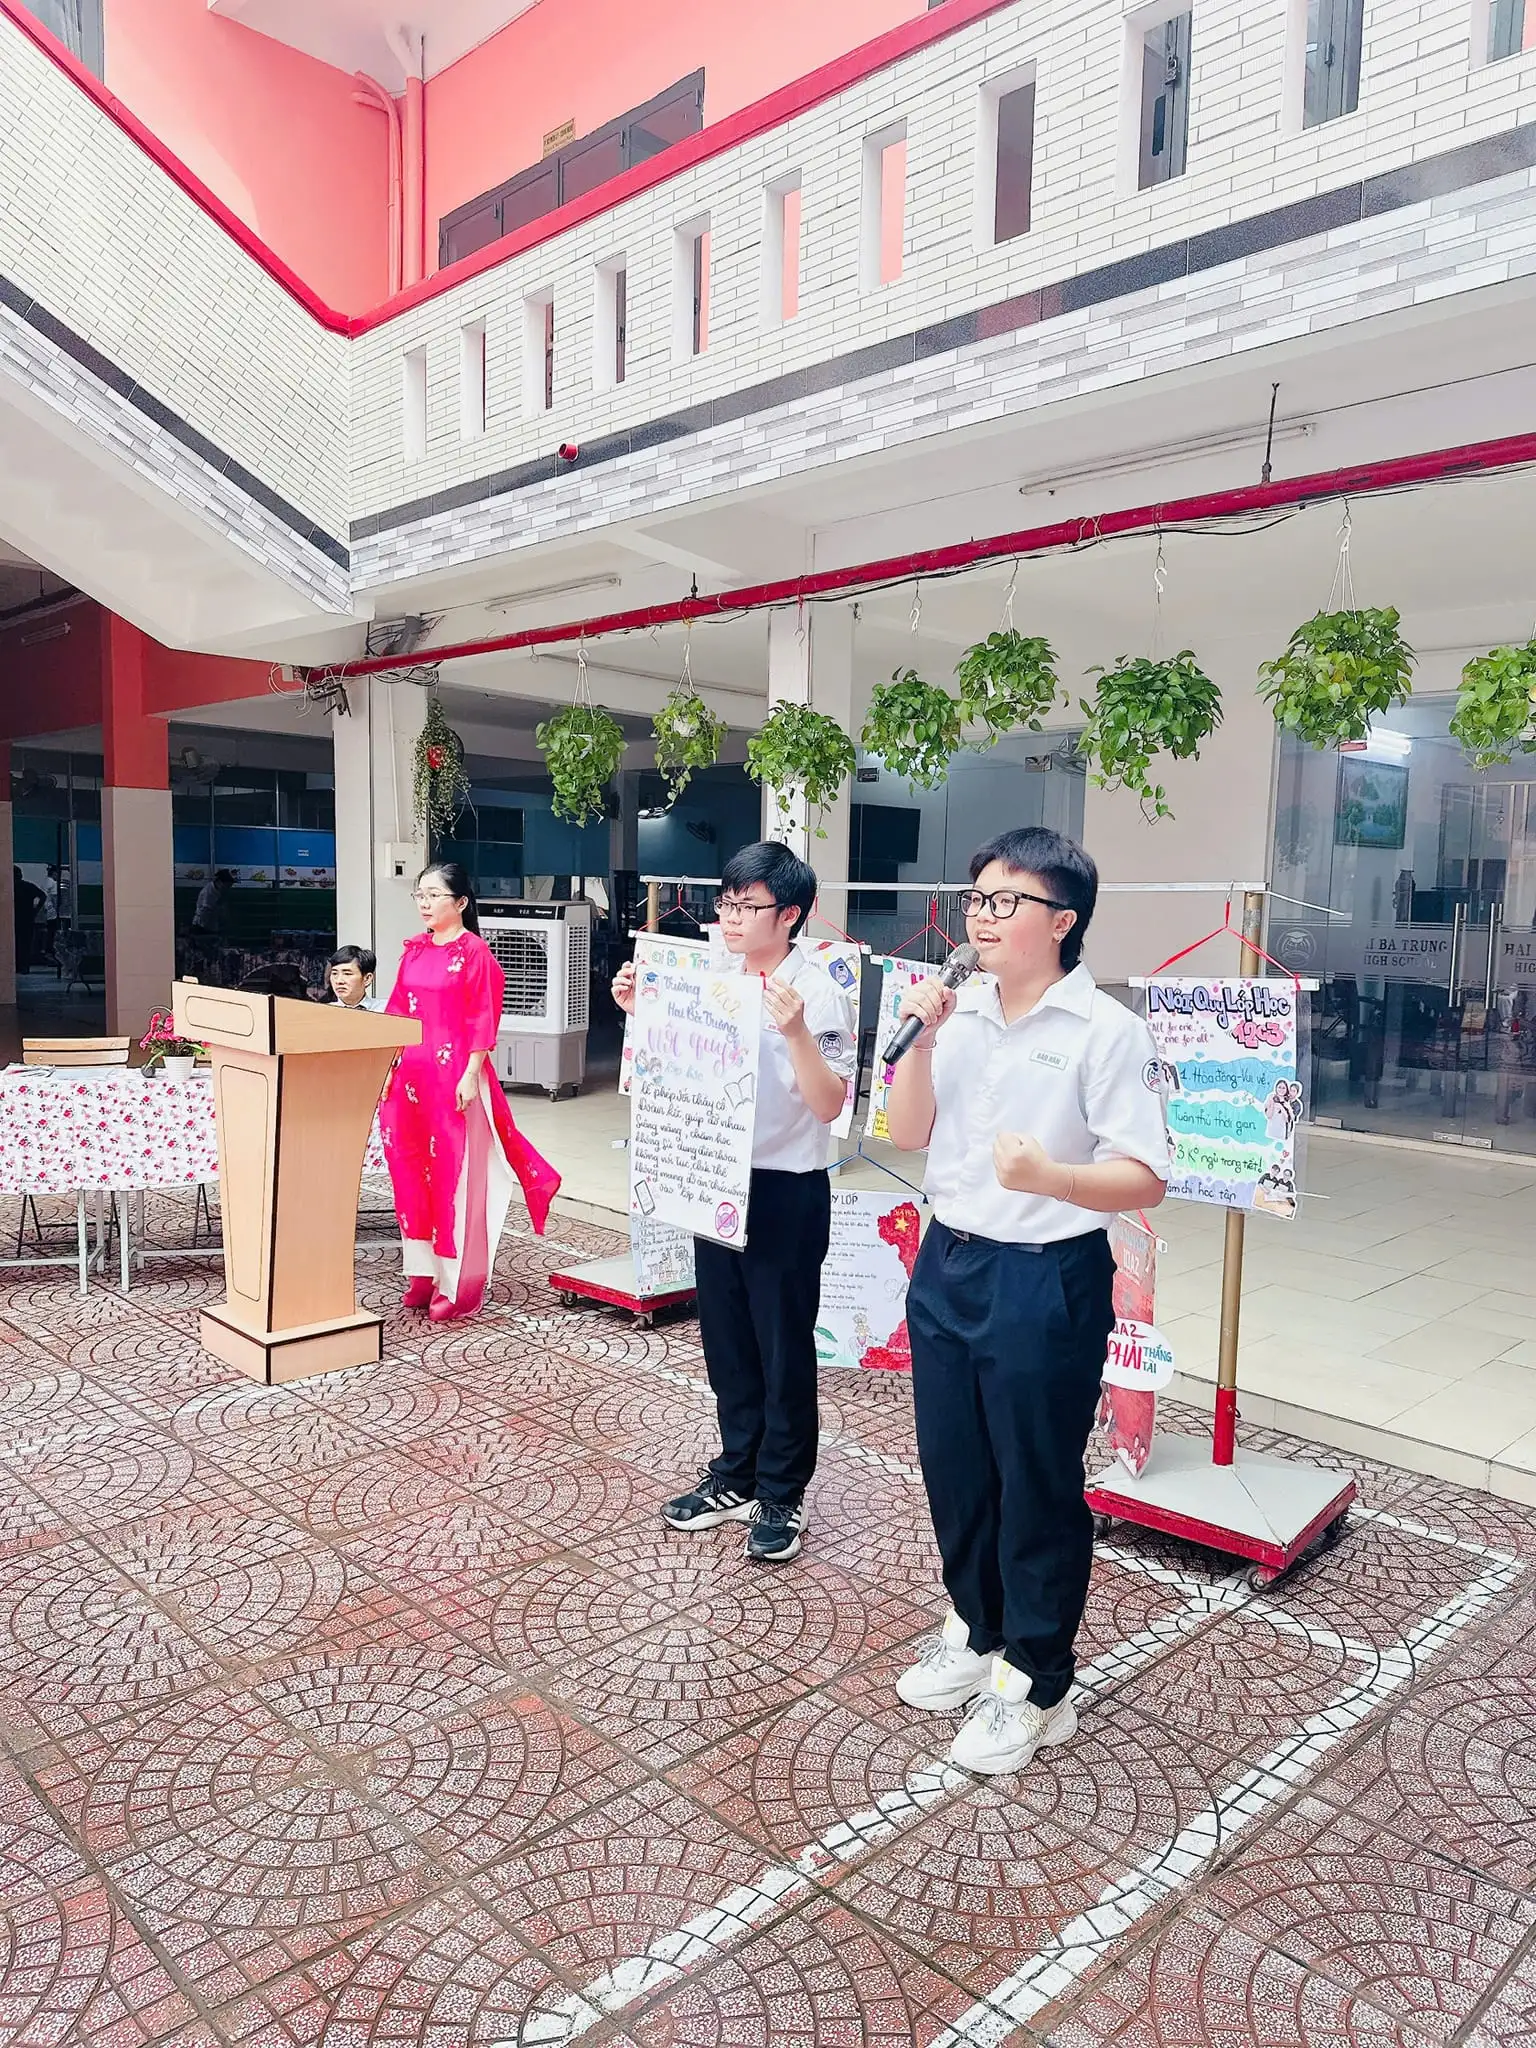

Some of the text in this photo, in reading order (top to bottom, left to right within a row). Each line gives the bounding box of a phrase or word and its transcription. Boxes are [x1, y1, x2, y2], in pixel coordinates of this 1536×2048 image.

[1504, 943, 1531, 956] HAI
[1192, 986, 1229, 1029] Quy
[1223, 987, 1254, 1022] Lớp
[1251, 986, 1291, 1017] Học
[1107, 1340, 1142, 1370] PHẢI
